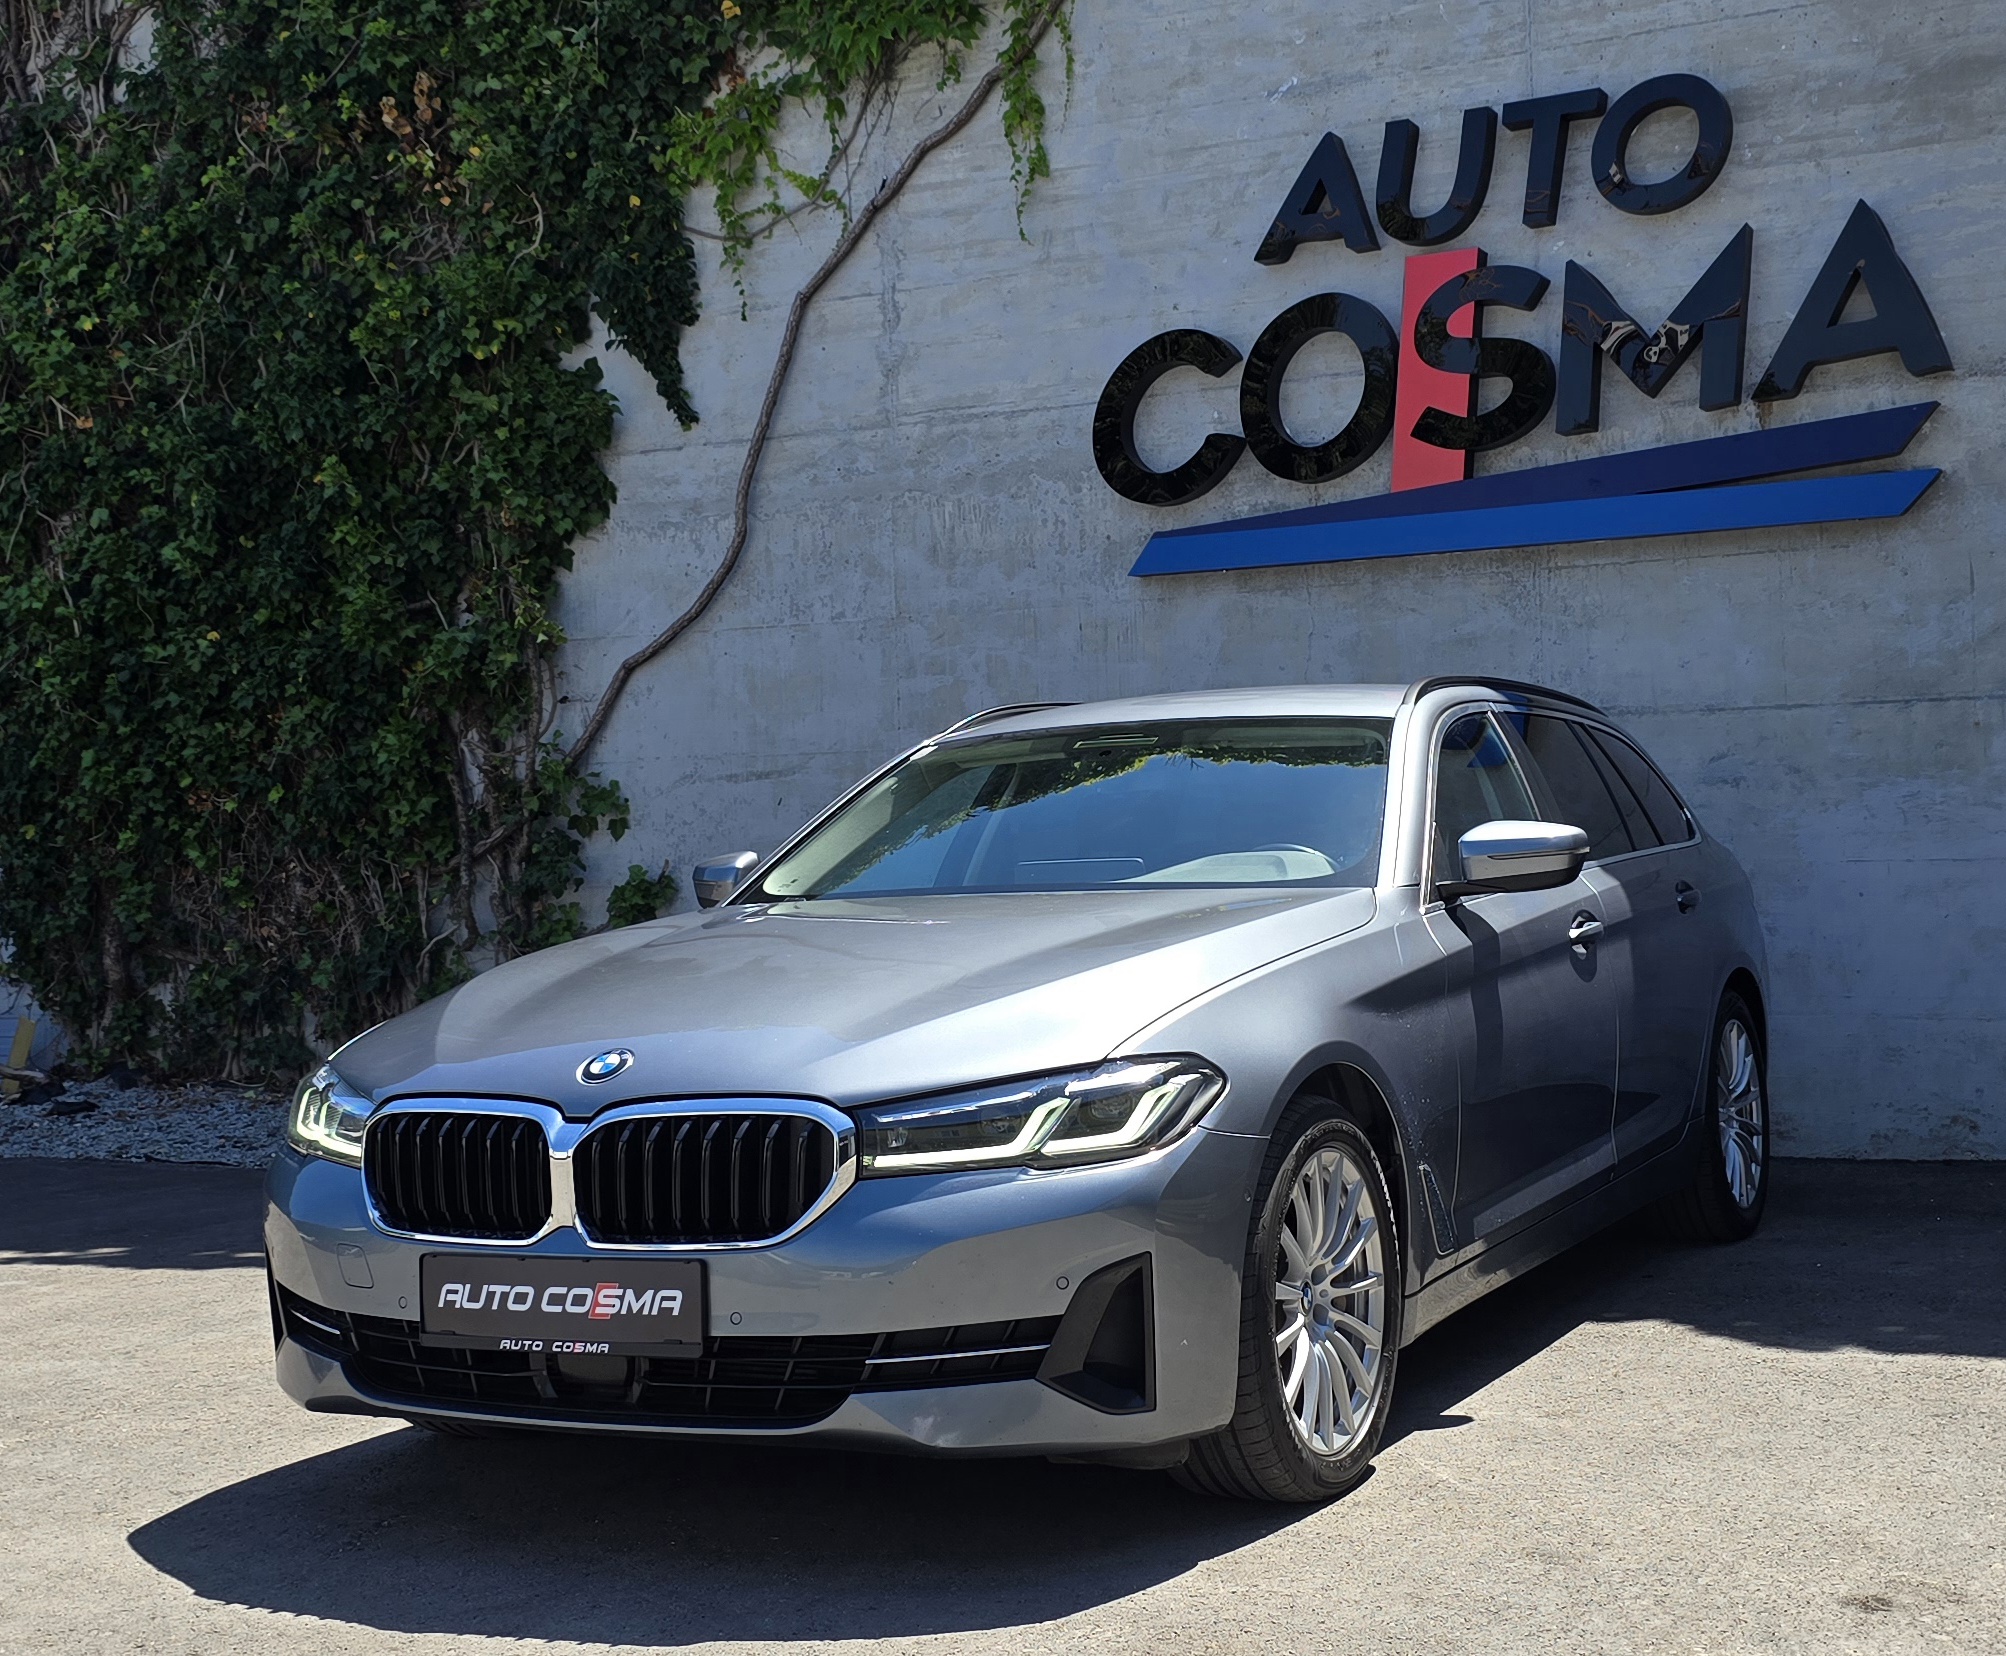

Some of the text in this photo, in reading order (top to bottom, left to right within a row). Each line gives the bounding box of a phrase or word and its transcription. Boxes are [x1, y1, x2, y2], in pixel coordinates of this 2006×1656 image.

[1254, 73, 1734, 266] AUTO
[1092, 198, 1955, 507] COSMA
[438, 1283, 683, 1316] AUTO COSMA
[500, 1339, 610, 1353] AUTO COSMA
